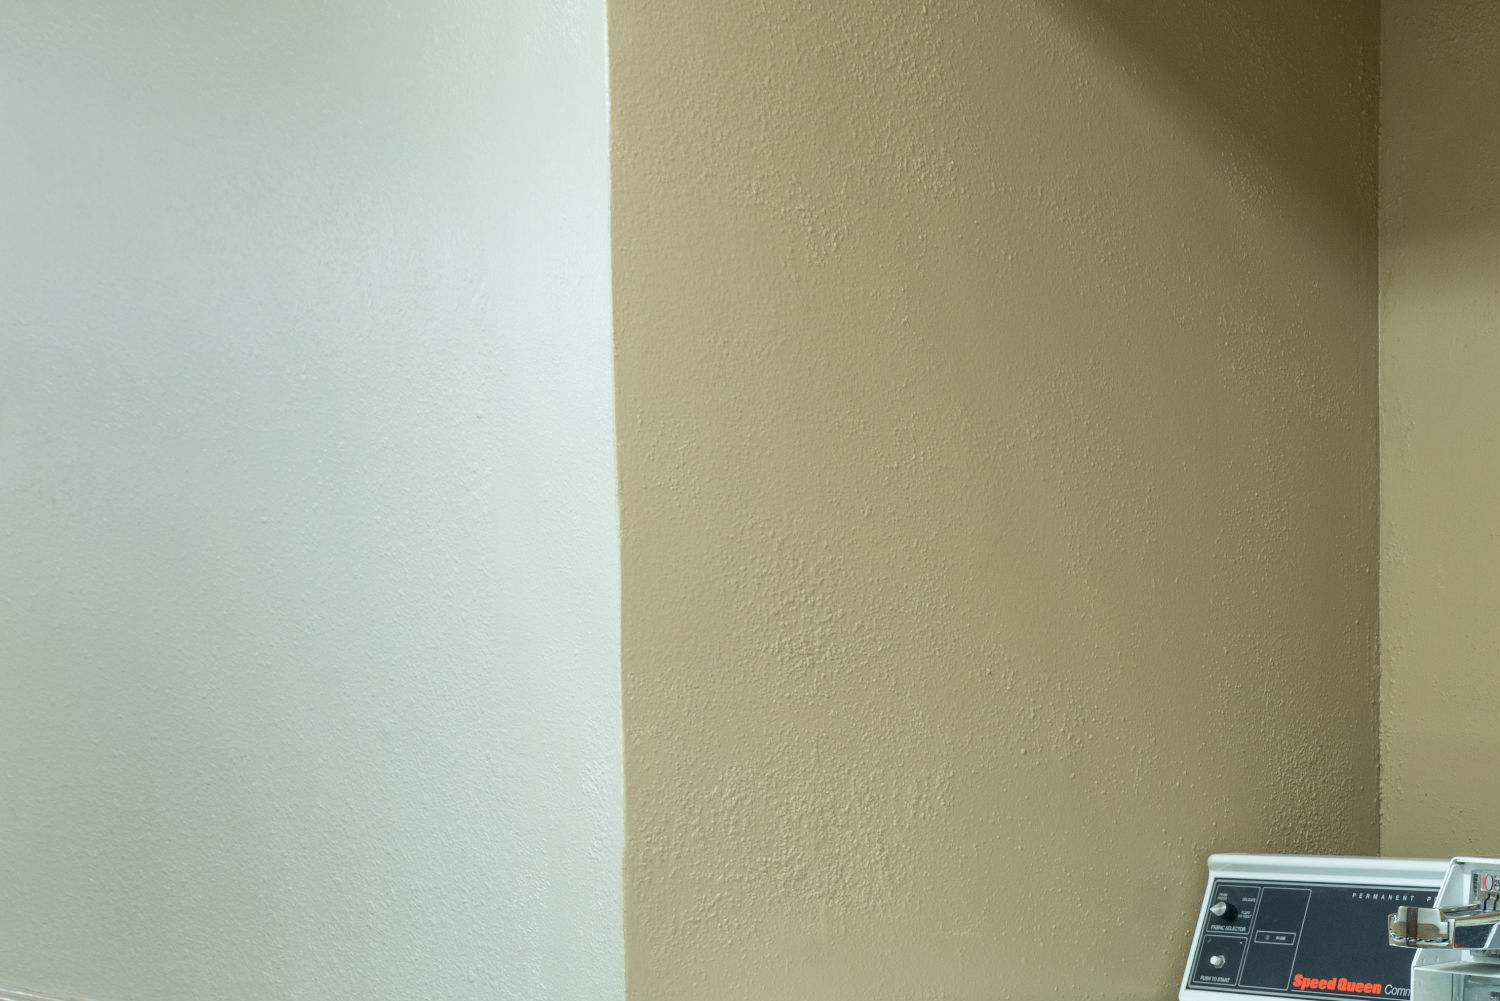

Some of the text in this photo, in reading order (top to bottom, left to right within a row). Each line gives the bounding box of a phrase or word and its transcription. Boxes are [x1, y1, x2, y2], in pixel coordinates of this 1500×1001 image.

[1352, 892, 1414, 901] PERMANENT
[1293, 973, 1337, 991] Speed
[1337, 977, 1382, 994] Queen
